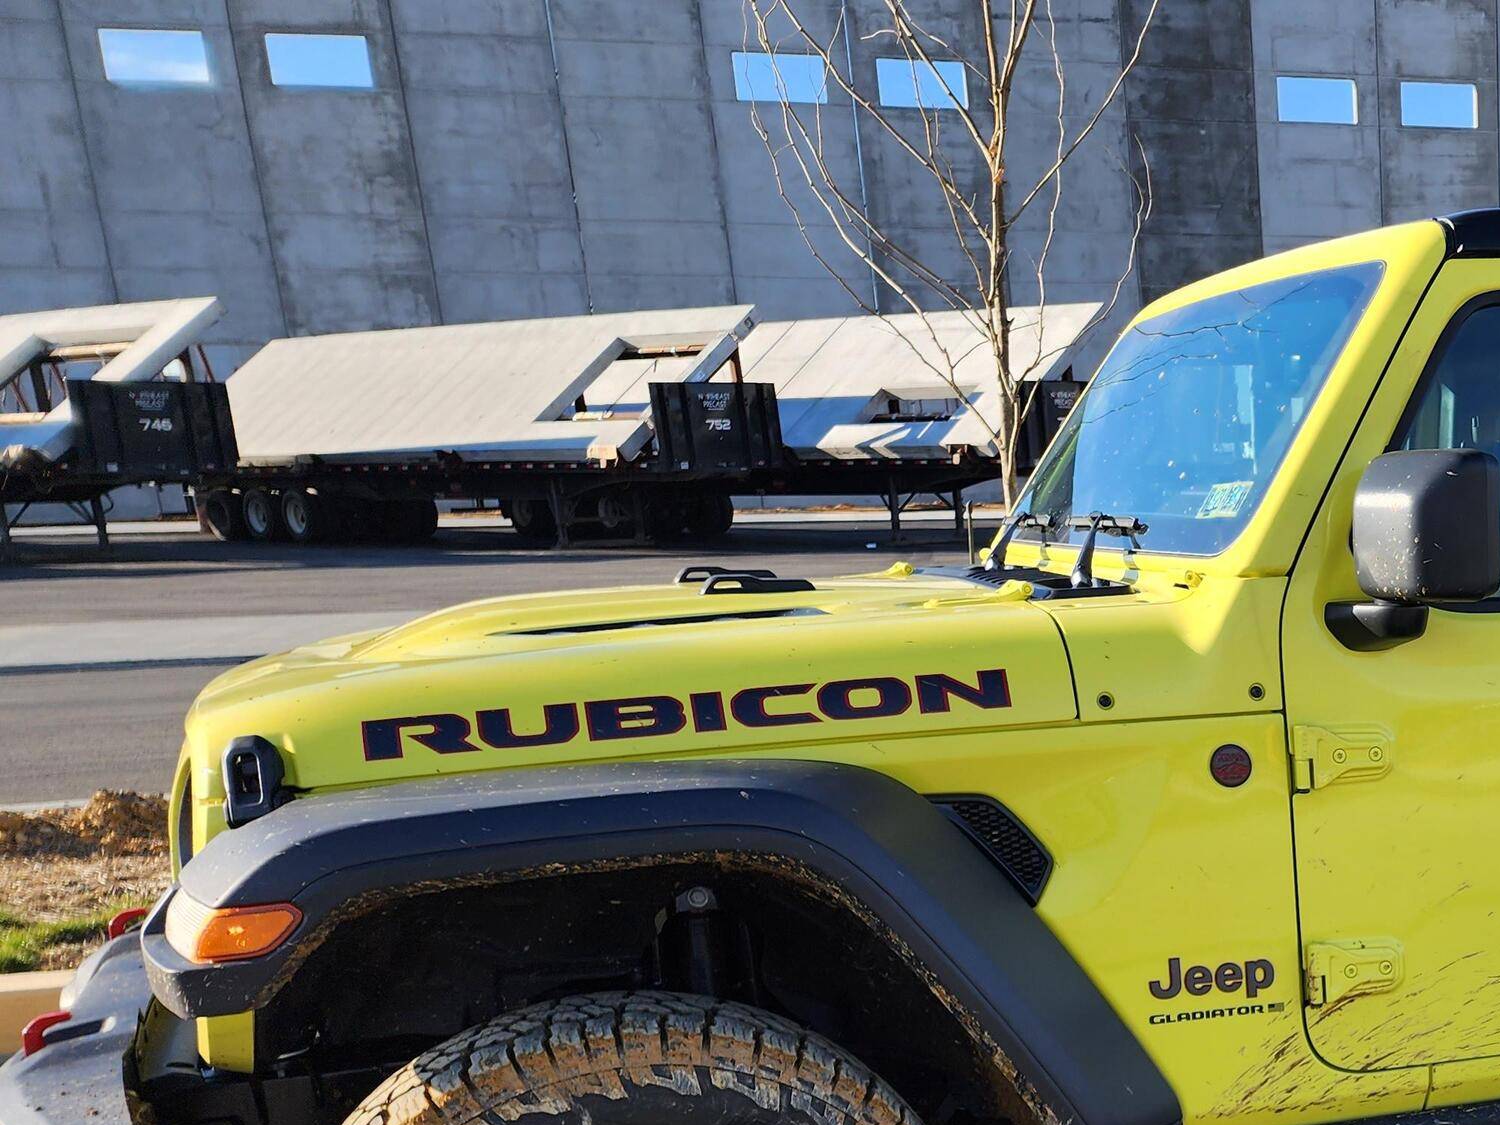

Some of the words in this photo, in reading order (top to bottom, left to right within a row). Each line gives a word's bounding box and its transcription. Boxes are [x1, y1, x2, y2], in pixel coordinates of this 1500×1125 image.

[705, 418, 732, 431] 752
[361, 668, 1013, 762] RUBICON
[1148, 957, 1275, 999] Jeep
[1149, 1005, 1264, 1025] GLADIATOR
